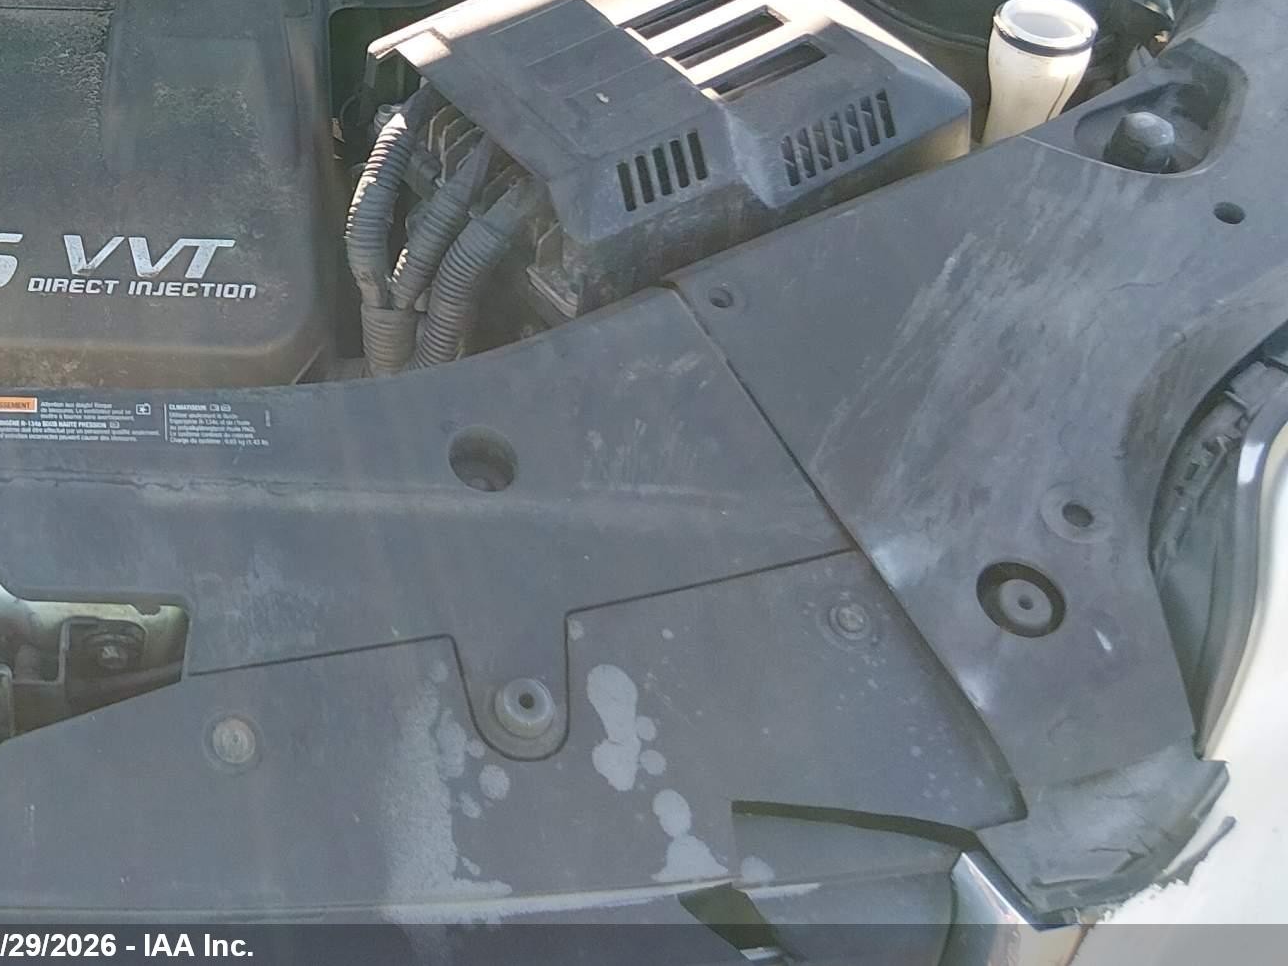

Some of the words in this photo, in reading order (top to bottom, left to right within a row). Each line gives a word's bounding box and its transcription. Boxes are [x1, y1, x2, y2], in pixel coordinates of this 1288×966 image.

[63, 234, 236, 279] VVT
[27, 278, 119, 295] DIRECT
[127, 280, 256, 299] INJECTION
